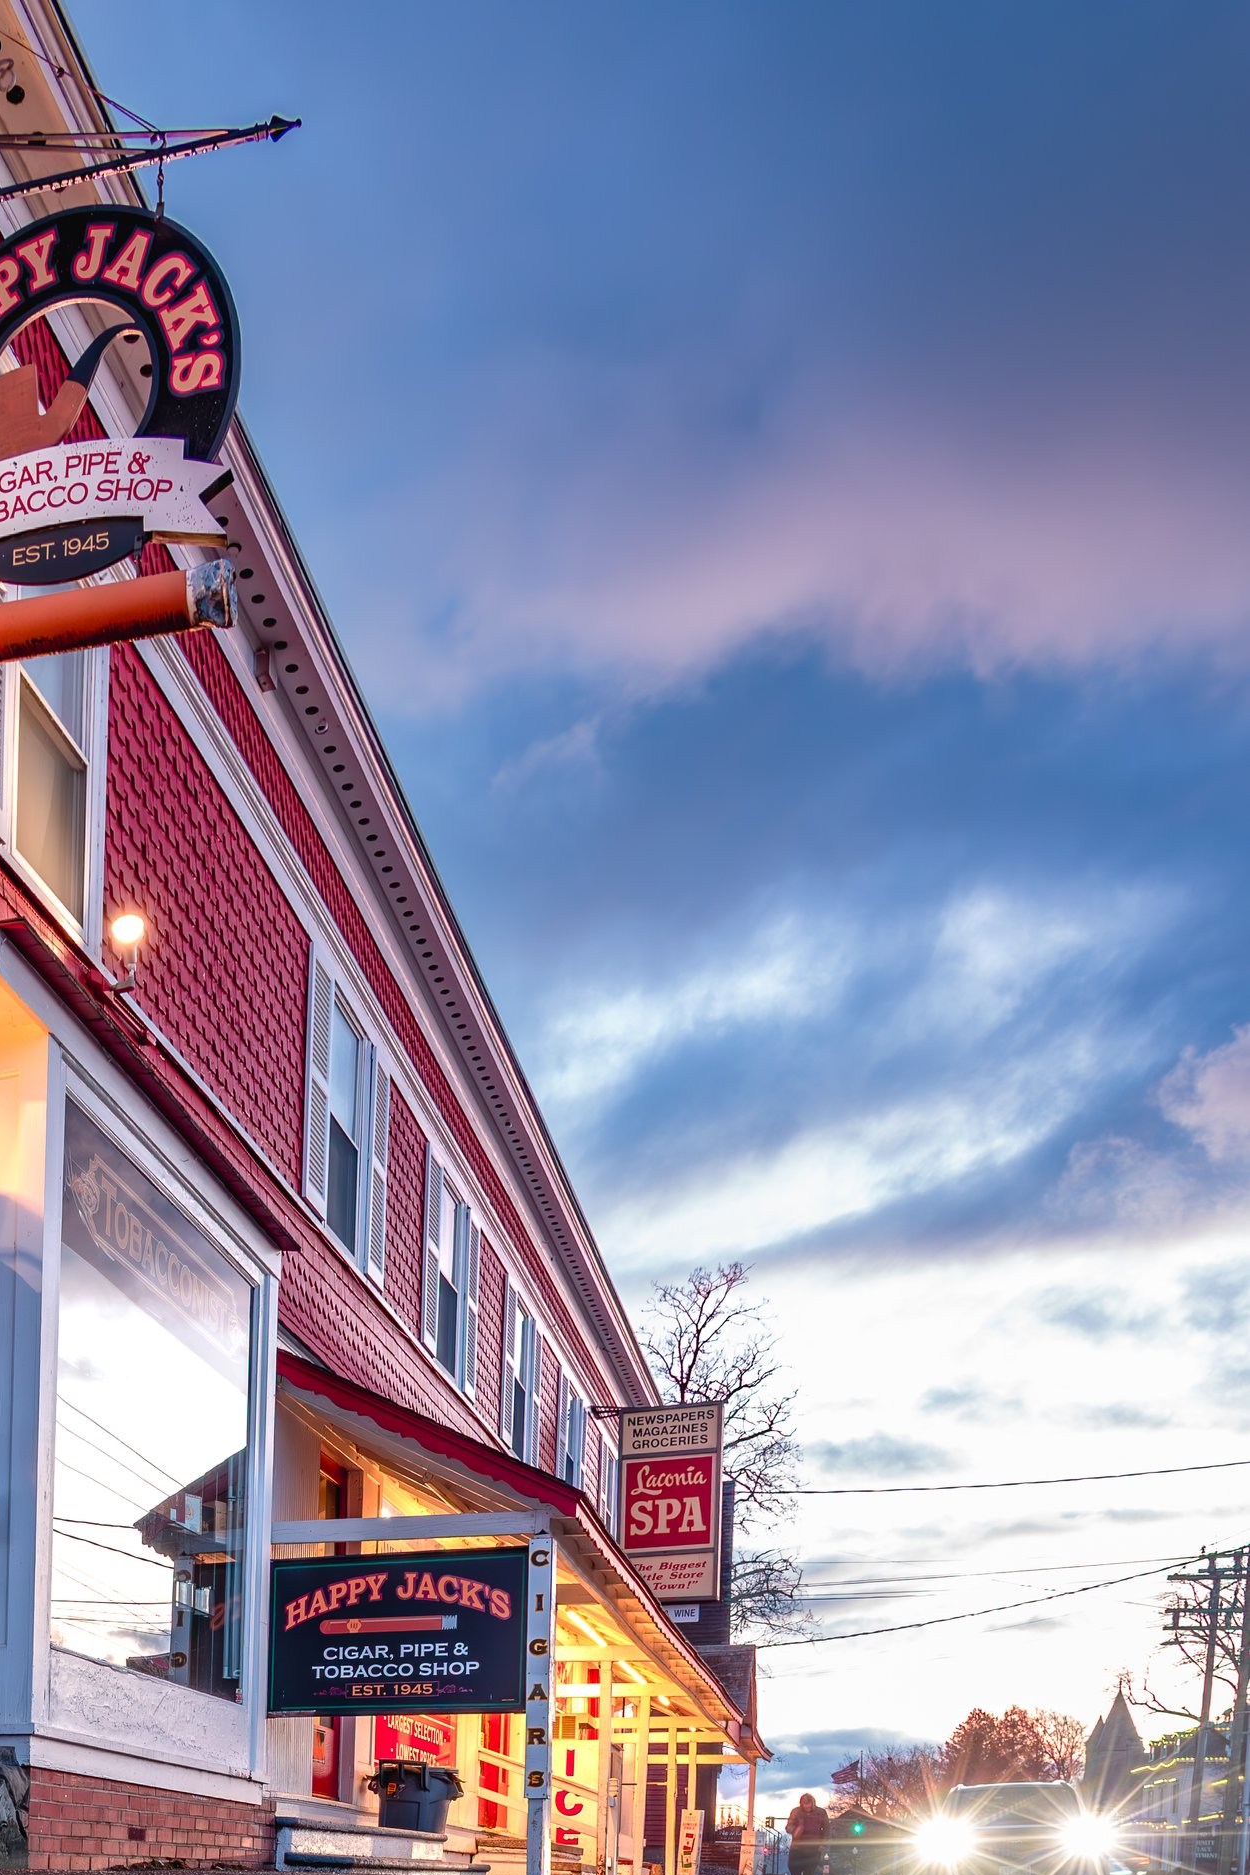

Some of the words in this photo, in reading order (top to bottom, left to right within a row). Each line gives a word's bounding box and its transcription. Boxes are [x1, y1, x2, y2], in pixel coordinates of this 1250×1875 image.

[72, 224, 224, 395] JACK'S
[64, 452, 121, 478] PIPE
[127, 452, 151, 475] &
[95, 478, 173, 503] SHOP
[12, 542, 57, 566] EST.
[62, 532, 110, 556] 1945
[100, 1174, 229, 1337] TOBACCONIST
[628, 1409, 715, 1427] NEWSPAPERS
[632, 1422, 708, 1438] MAGAZINES
[632, 1434, 708, 1450] GROCERIES
[630, 1464, 707, 1496] Laconia
[629, 1496, 707, 1537] SPA
[659, 1560, 707, 1571] Biggest
[669, 1570, 703, 1580] Store
[284, 1572, 388, 1631] HAPPY
[396, 1571, 512, 1621] JACK'S
[674, 1609, 696, 1618] WINE
[323, 1645, 394, 1661] CIGAR,
[399, 1643, 449, 1658] PIPE
[453, 1642, 469, 1656] &
[311, 1663, 414, 1680] TOBACCO
[419, 1661, 480, 1676] SHOP
[527, 1549, 550, 1788] CIGARS
[351, 1685, 387, 1697] EST.
[393, 1683, 433, 1695] 1945
[387, 1715, 413, 1736] LARGEST
[414, 1721, 444, 1746] SELECTION
[395, 1746, 419, 1761] LOWEST
